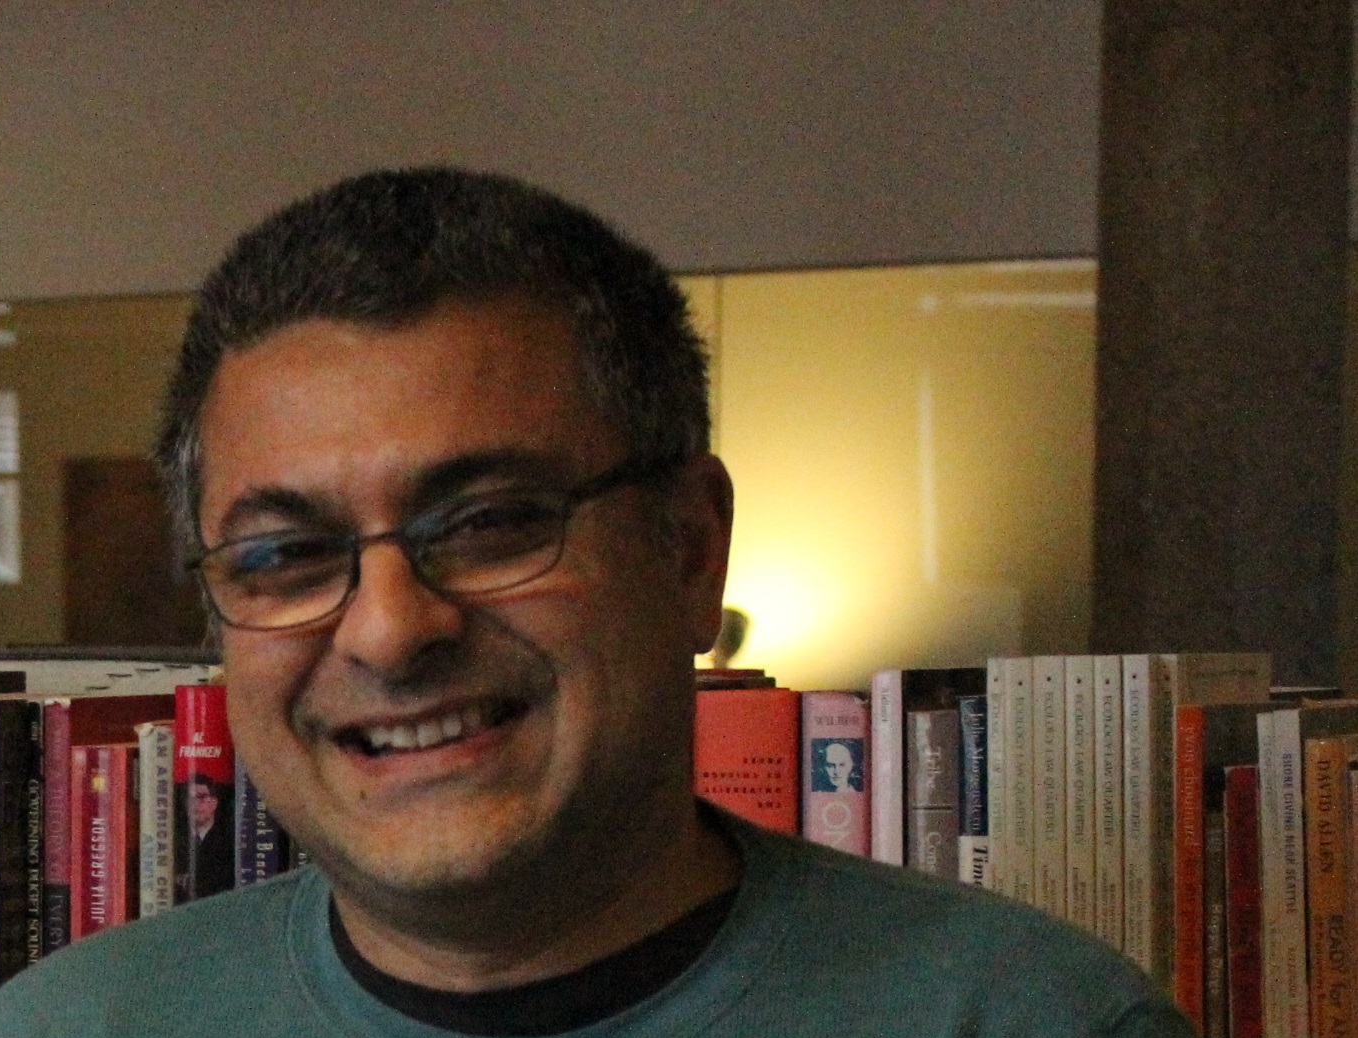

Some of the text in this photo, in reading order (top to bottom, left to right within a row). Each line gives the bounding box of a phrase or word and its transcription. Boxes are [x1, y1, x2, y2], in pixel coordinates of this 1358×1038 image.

[1044, 692, 1054, 745] ECOLOGY
[1074, 694, 1085, 747] ECOLOGY
[1129, 689, 1140, 742] ECOLOGY
[179, 746, 222, 758] FRANKEN
[970, 710, 984, 831] Julie Morgenstern
[1044, 750, 1054, 772] LAW
[1074, 752, 1085, 775] LAW
[1102, 695, 1113, 847] ECOLOGY LAW QUARTERLY
[1129, 748, 1140, 770] LAW
[28, 779, 40, 864] GOVERNING
[156, 732, 168, 910] AN AMERICAN CHI
[256, 795, 273, 835] mock
[1283, 753, 1296, 914] SHORE DIVING NEAR SEATTLE
[1317, 760, 1334, 874] DAVID ALLEN
[28, 869, 39, 914] PUGET
[90, 817, 105, 923] JULIA GREGSON
[1329, 915, 1345, 971] READY
